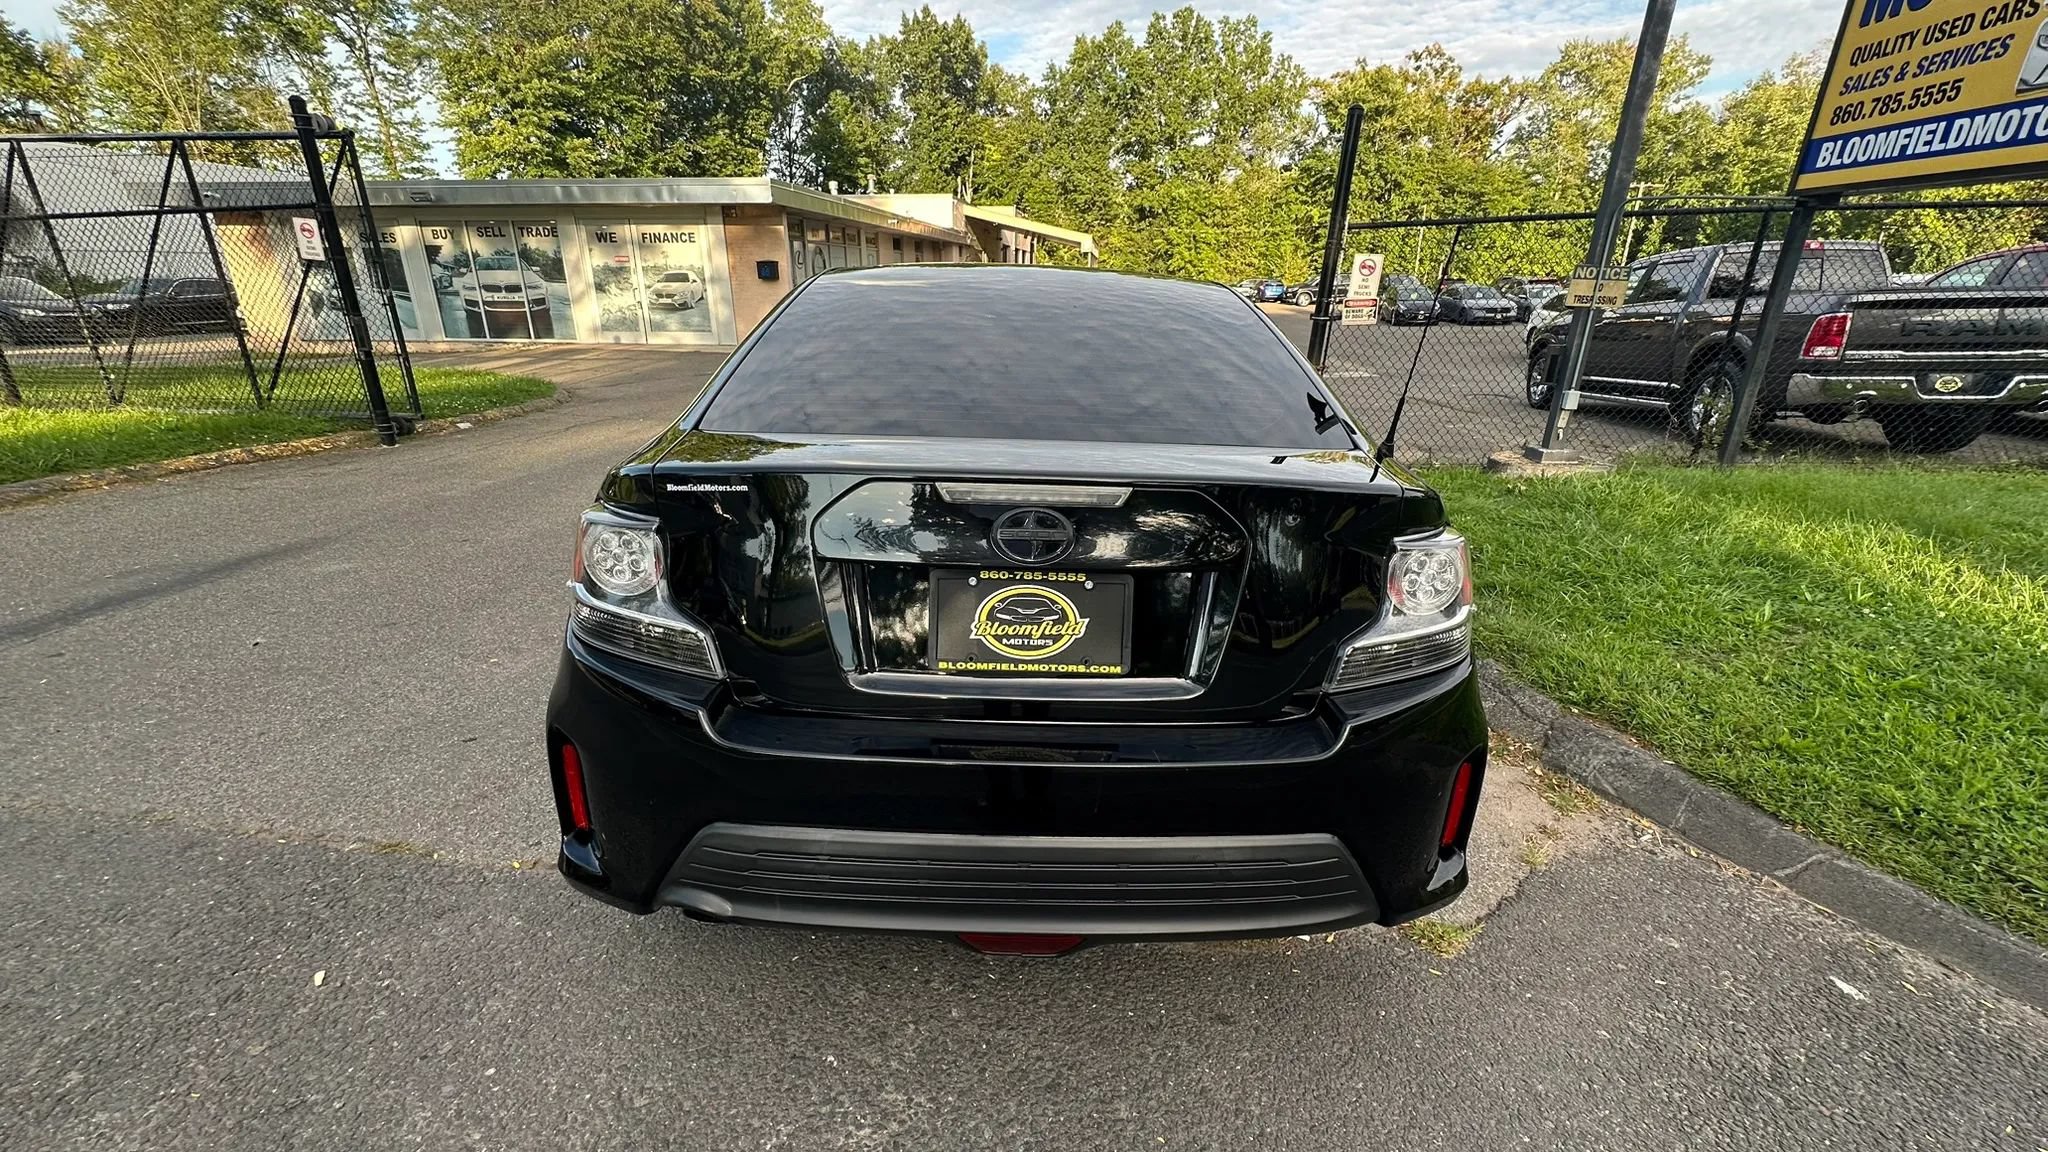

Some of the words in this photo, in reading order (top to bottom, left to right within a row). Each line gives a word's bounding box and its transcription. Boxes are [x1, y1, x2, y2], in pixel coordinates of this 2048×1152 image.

[1859, 0, 1933, 28] M
[1849, 28, 1922, 67] QUALITY
[1922, 13, 1976, 46] USED
[1980, 0, 2041, 31] CARS
[1838, 65, 1894, 97] SALES
[1893, 60, 1911, 83] &
[1911, 33, 2016, 78] SERVICES
[1829, 78, 1965, 127] 860.785.5555
[360, 232, 397, 244] SES
[431, 229, 455, 240] BUY
[476, 226, 506, 238] SELL
[518, 226, 559, 238] TRADE
[595, 232, 618, 243] WE
[641, 232, 697, 243] FINANCE
[1573, 294, 1618, 306] TRESPSSING
[666, 483, 749, 492] BloomfieldMotors.com
[979, 570, 1086, 582] 860-785-5555
[976, 620, 1084, 639] Bloomfield
[1001, 637, 1054, 646] MOTORS
[938, 661, 1121, 674] BLOOMFIELDMOTORS.COM
